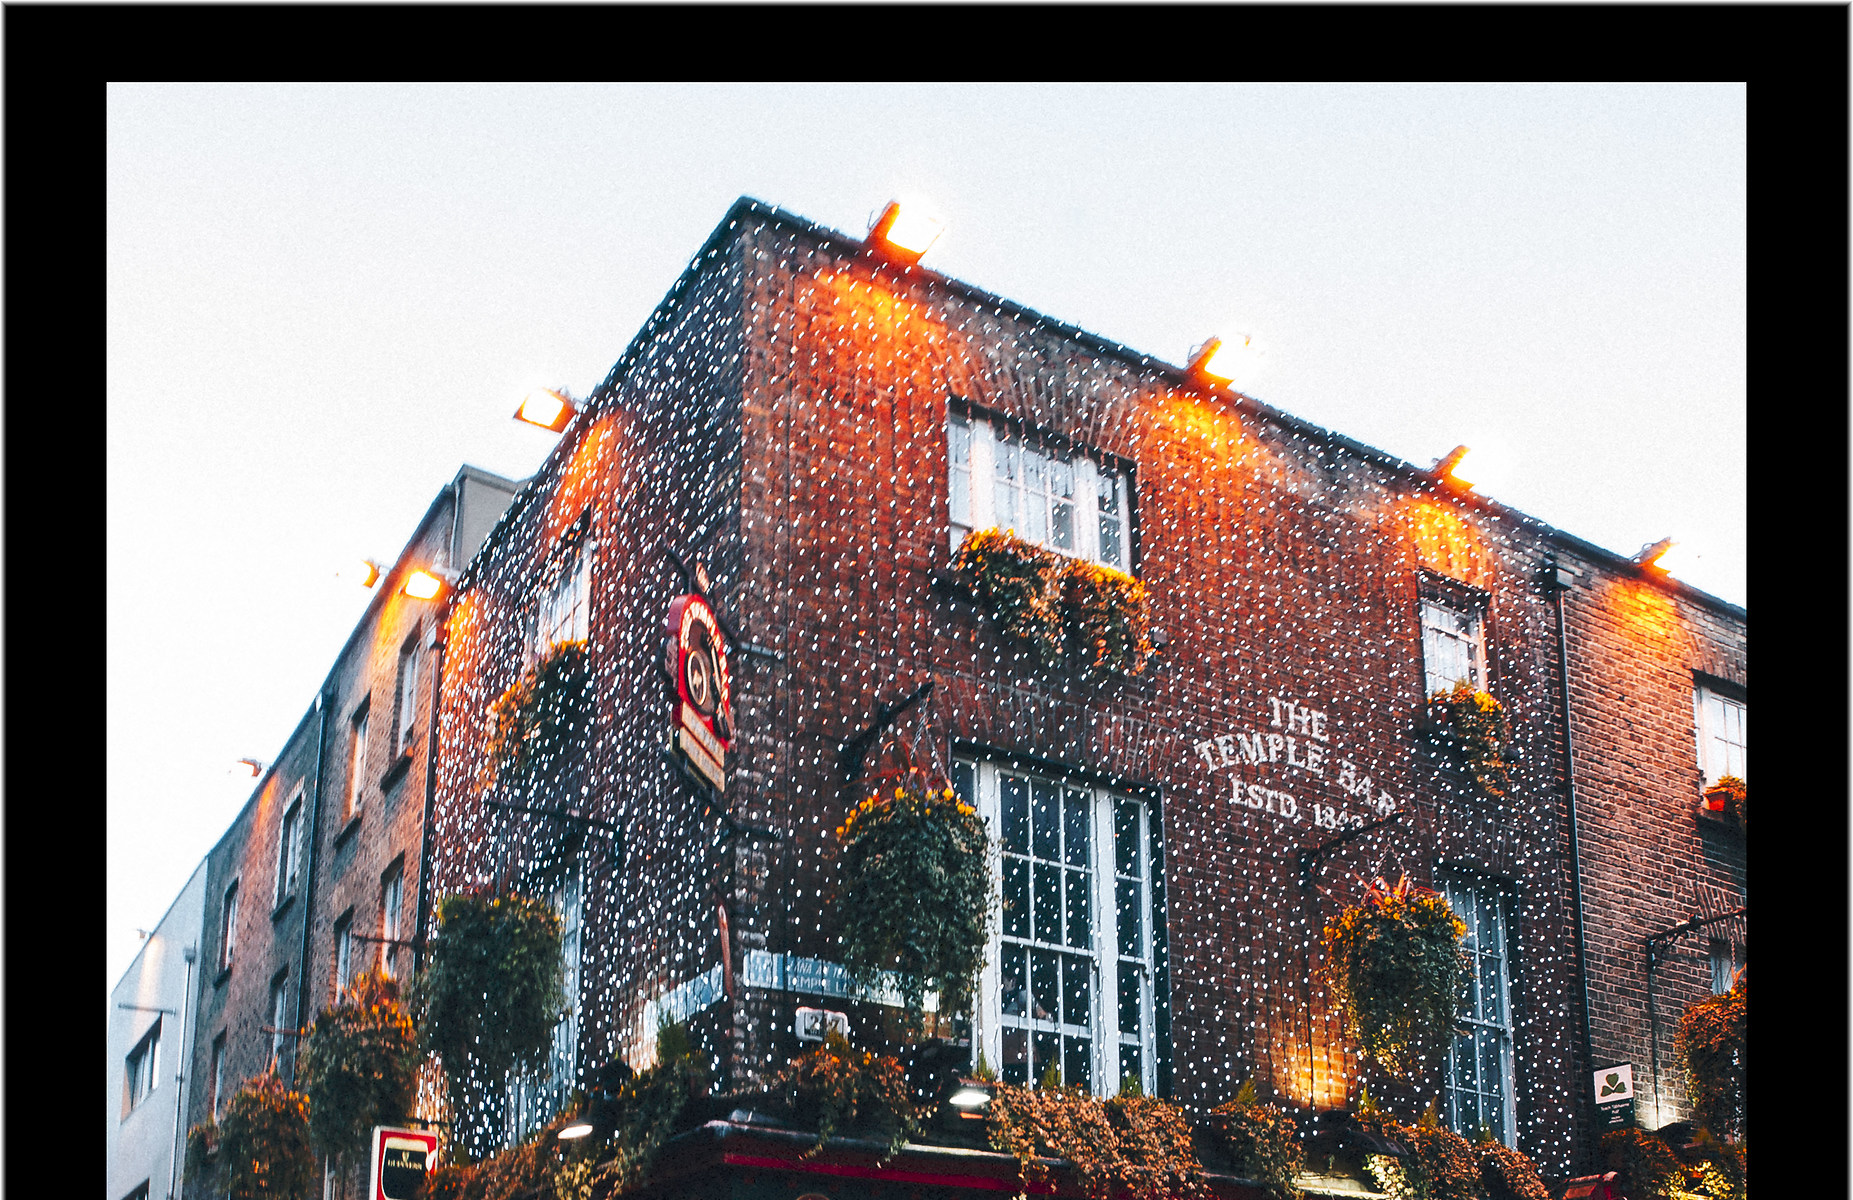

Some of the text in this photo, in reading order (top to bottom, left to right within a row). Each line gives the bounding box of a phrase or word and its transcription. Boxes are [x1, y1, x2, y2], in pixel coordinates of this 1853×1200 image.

[1267, 697, 1329, 742] THE
[1194, 733, 1396, 817] TEMPLE BAR
